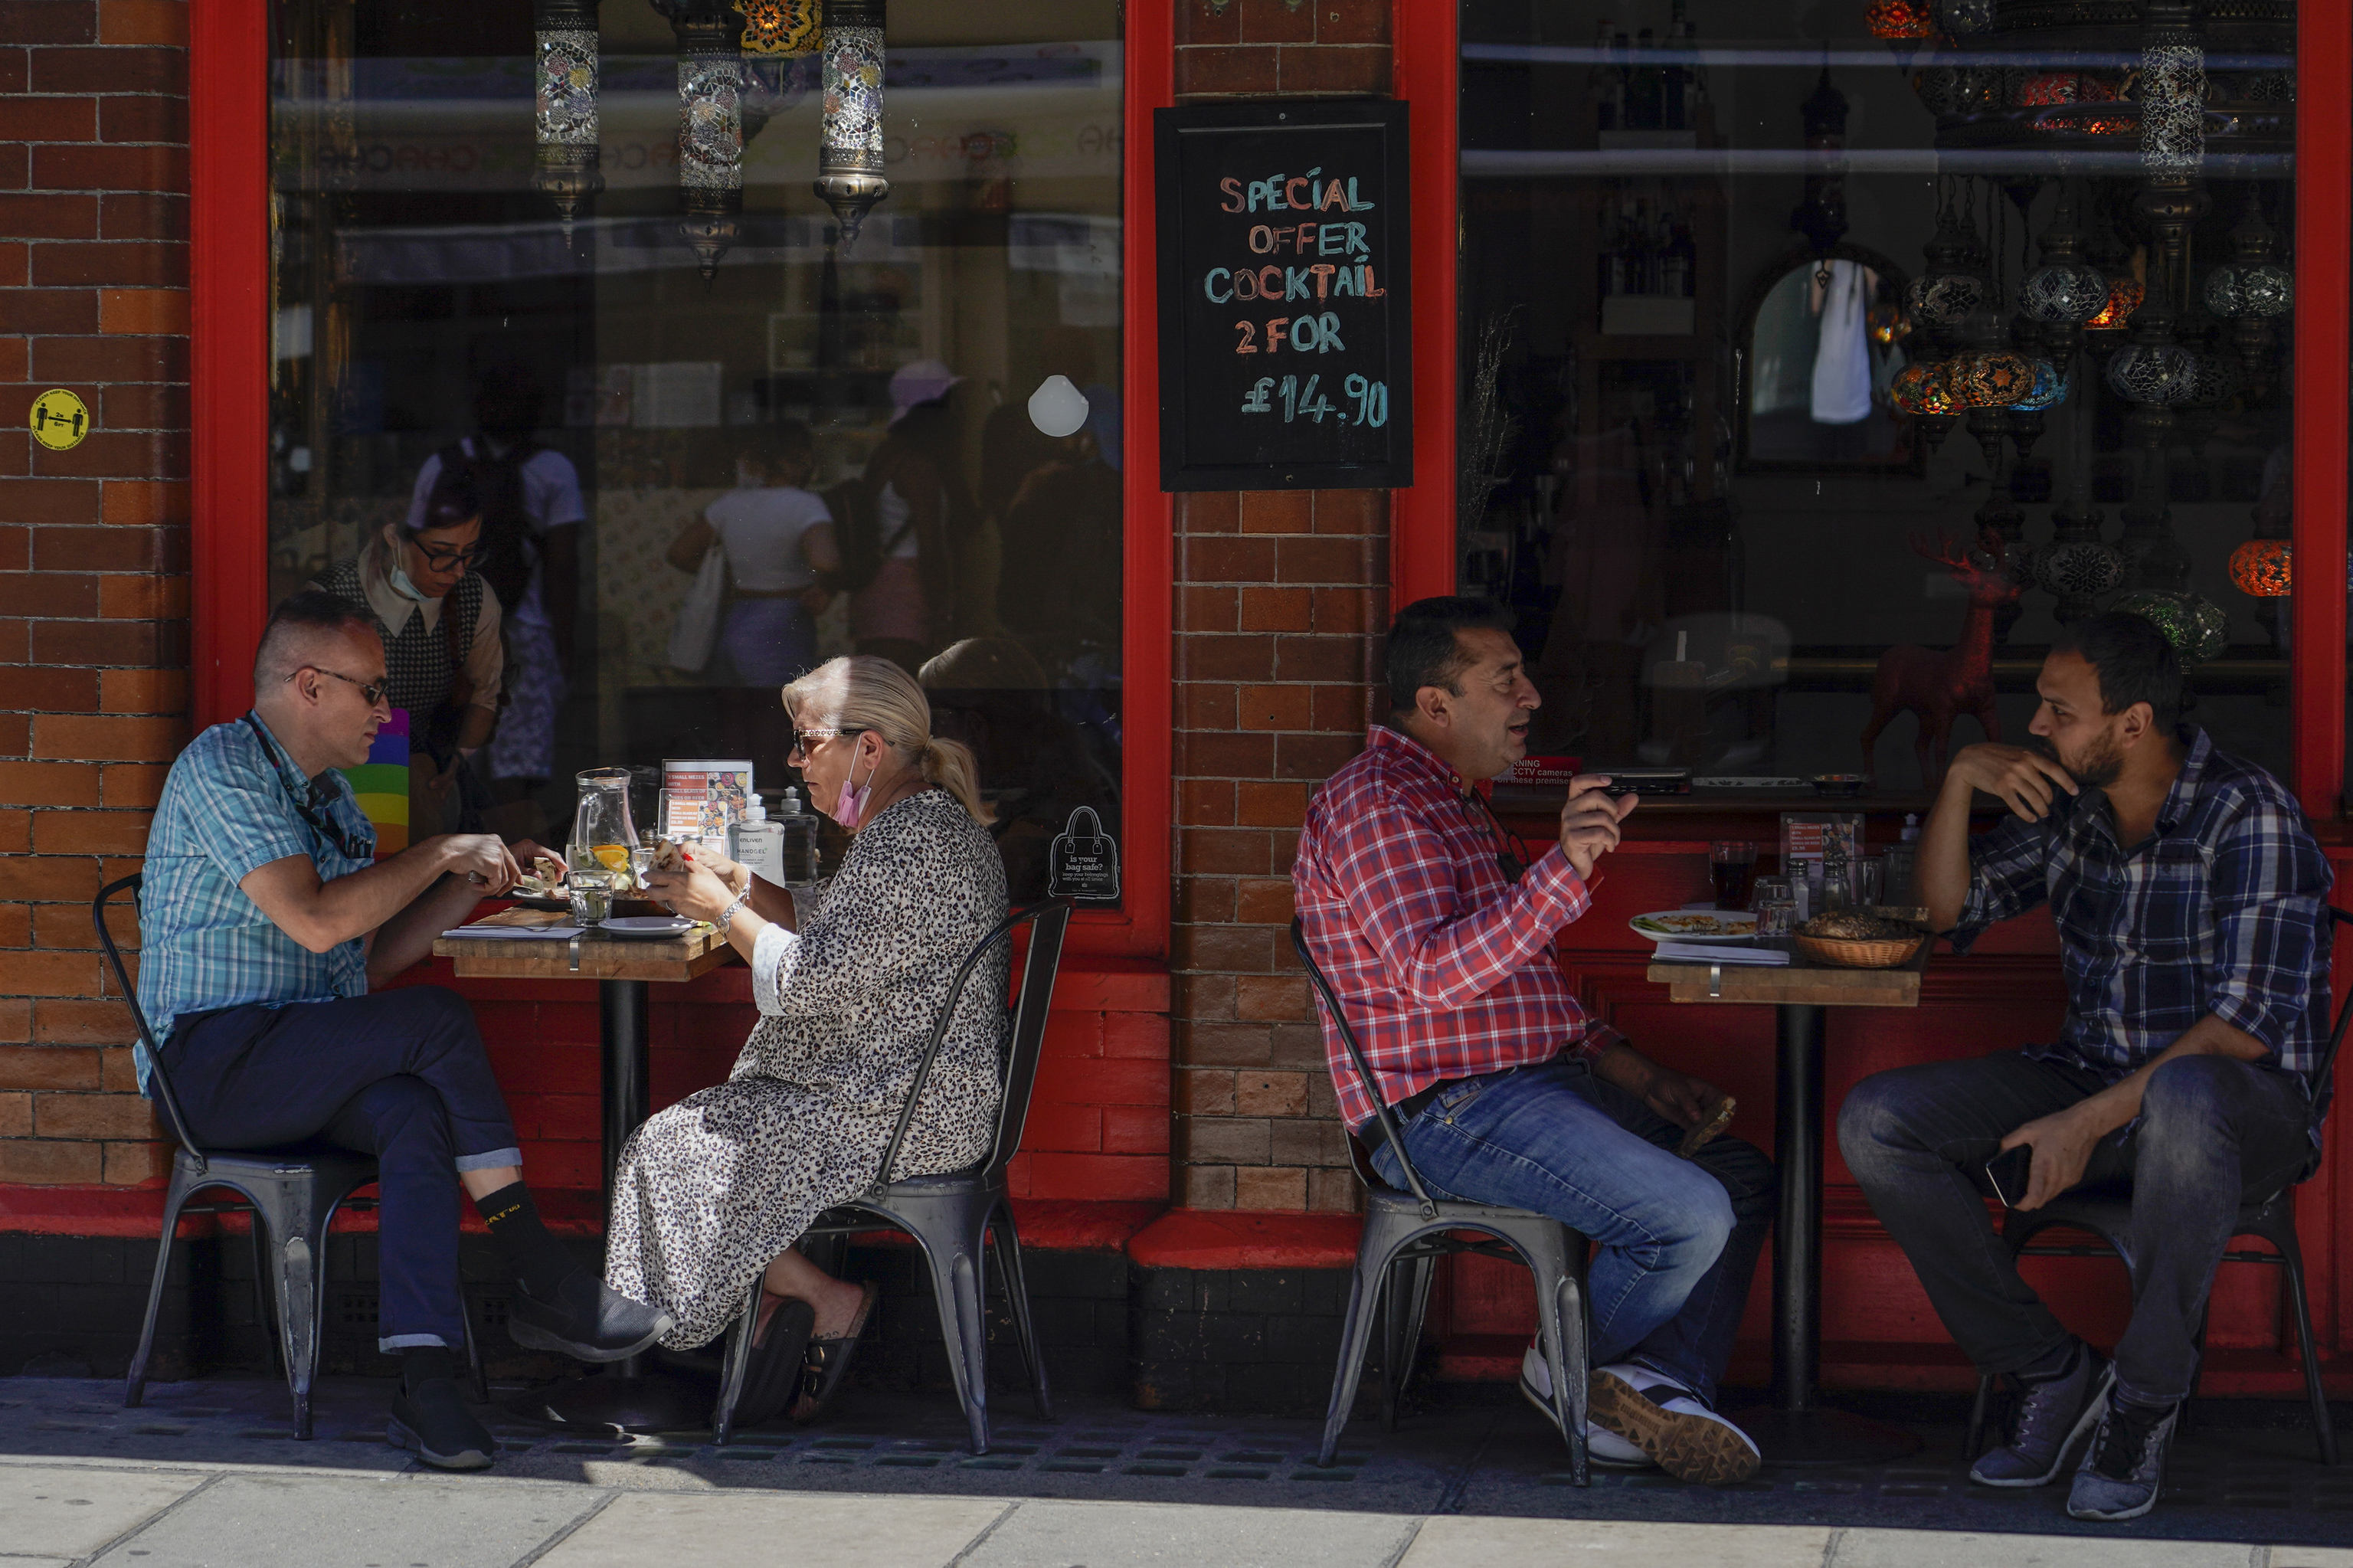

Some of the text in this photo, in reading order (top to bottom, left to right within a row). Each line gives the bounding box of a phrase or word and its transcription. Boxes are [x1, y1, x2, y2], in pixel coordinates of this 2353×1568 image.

[1248, 222, 1370, 256] OFFER
[1235, 311, 1346, 354] 2 FOR
[35, 393, 49, 405] PLEASE
[73, 395, 87, 415] DISTANCE
[1241, 372, 1387, 428] £14.90
[32, 425, 43, 441] PLEASE
[67, 432, 83, 449] DISTANCE
[1513, 768, 1536, 776] CCTV
[1536, 777, 1570, 785] premise
[1065, 863, 1082, 872] bag
